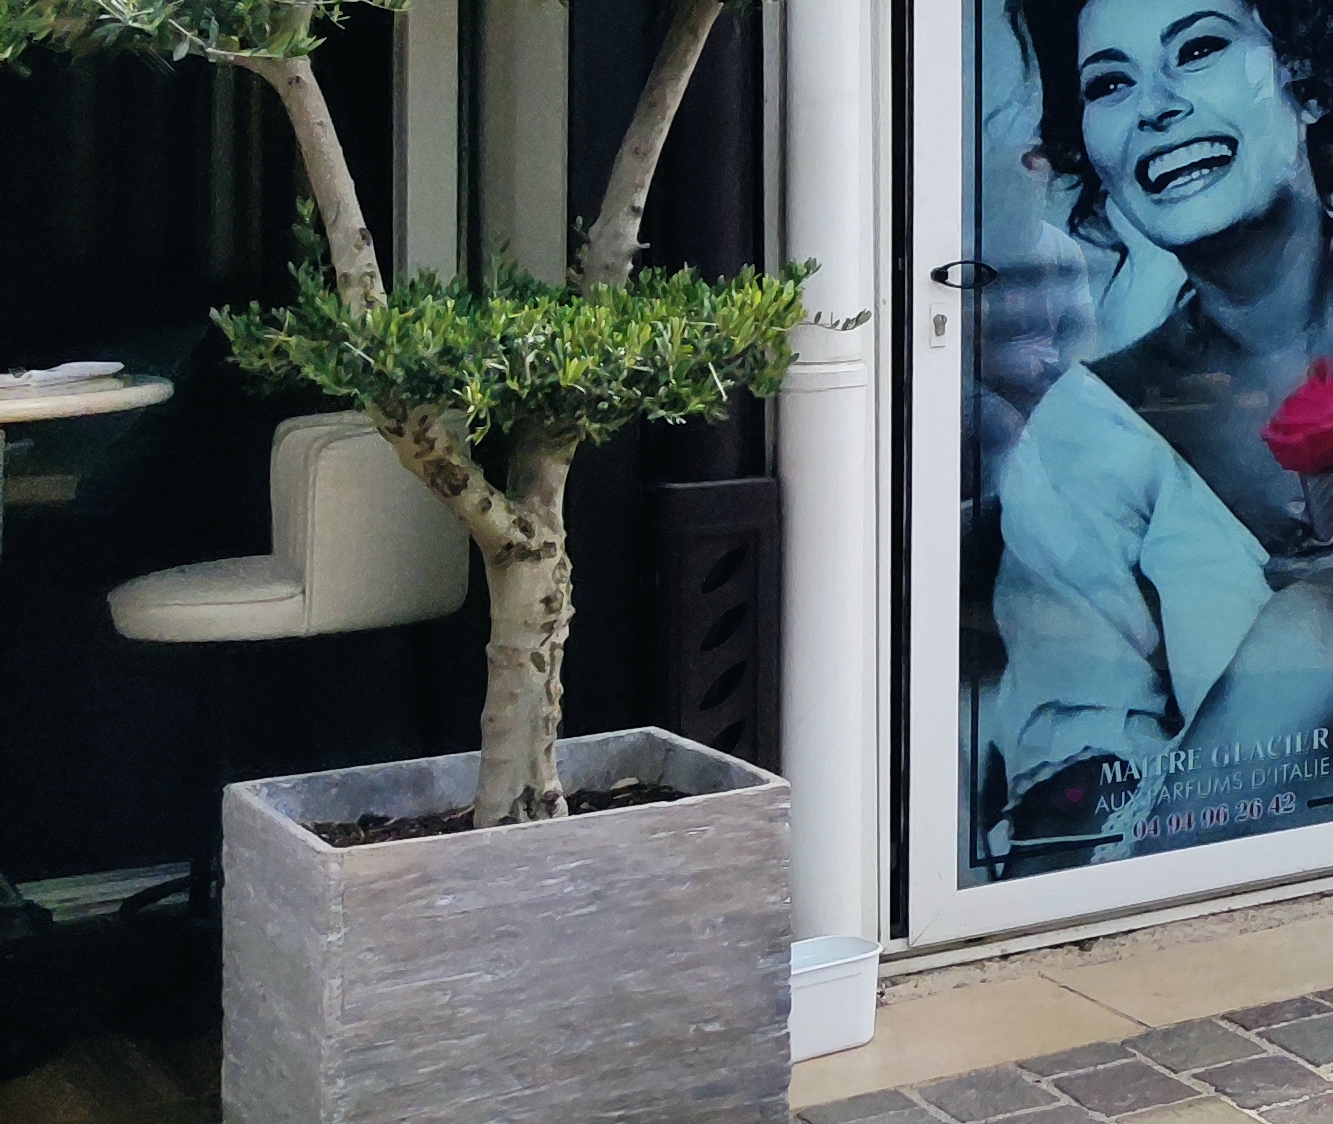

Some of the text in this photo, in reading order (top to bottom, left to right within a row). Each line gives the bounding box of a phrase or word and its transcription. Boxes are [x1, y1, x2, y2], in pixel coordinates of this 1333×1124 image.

[1211, 727, 1330, 768] GLACIER
[1095, 756, 1331, 817] AUX PARFUMS D'ITALIE
[1132, 791, 1297, 841] 04 94 96 26 42
